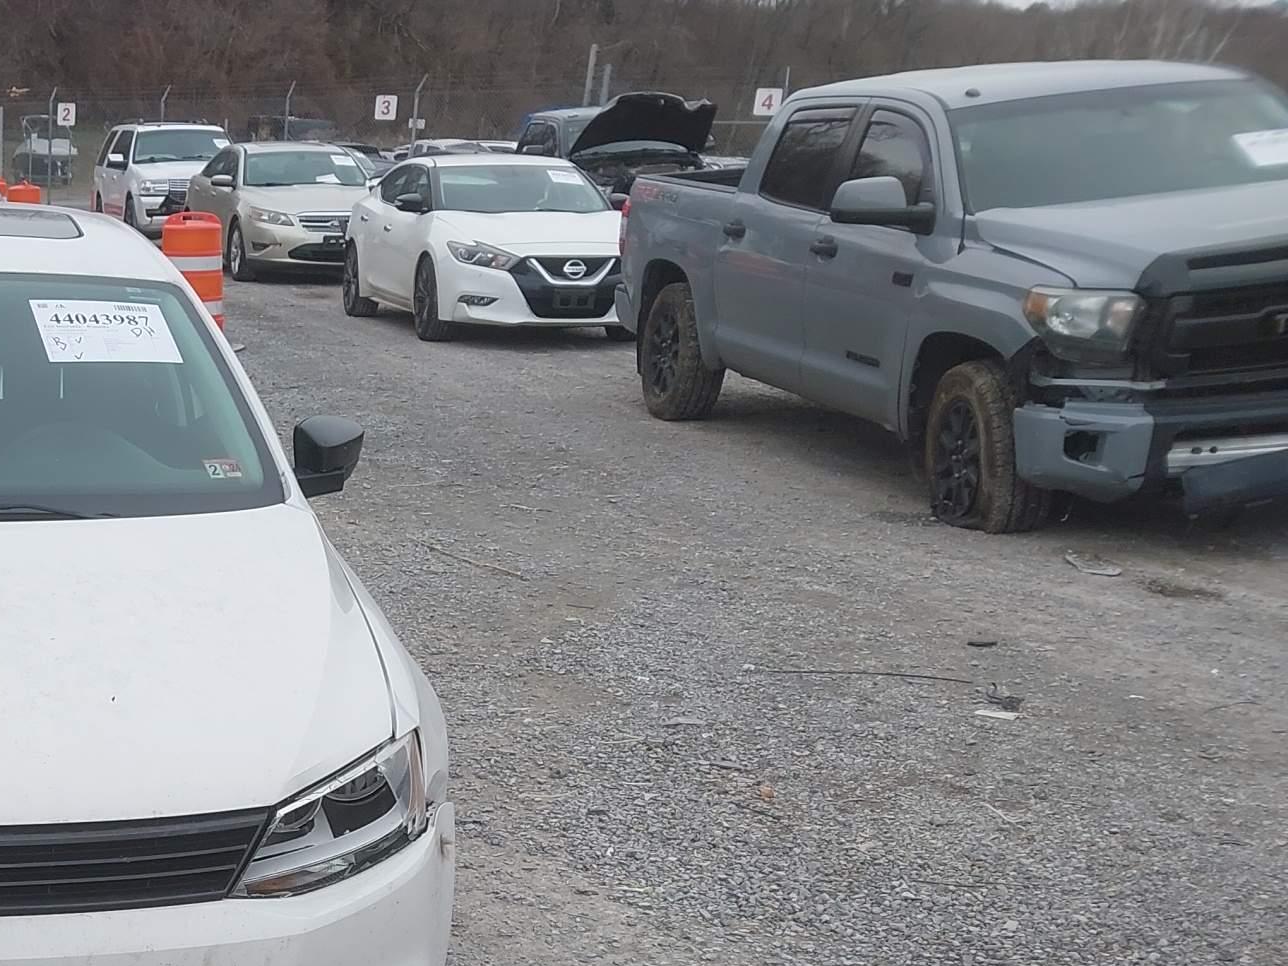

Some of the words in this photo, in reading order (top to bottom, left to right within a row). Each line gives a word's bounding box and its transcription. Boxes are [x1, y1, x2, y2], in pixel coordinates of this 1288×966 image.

[381, 100, 391, 115] 3
[761, 94, 773, 110] 4
[62, 107, 71, 121] 2
[49, 313, 148, 327] 44043987
[208, 464, 221, 476] 2
